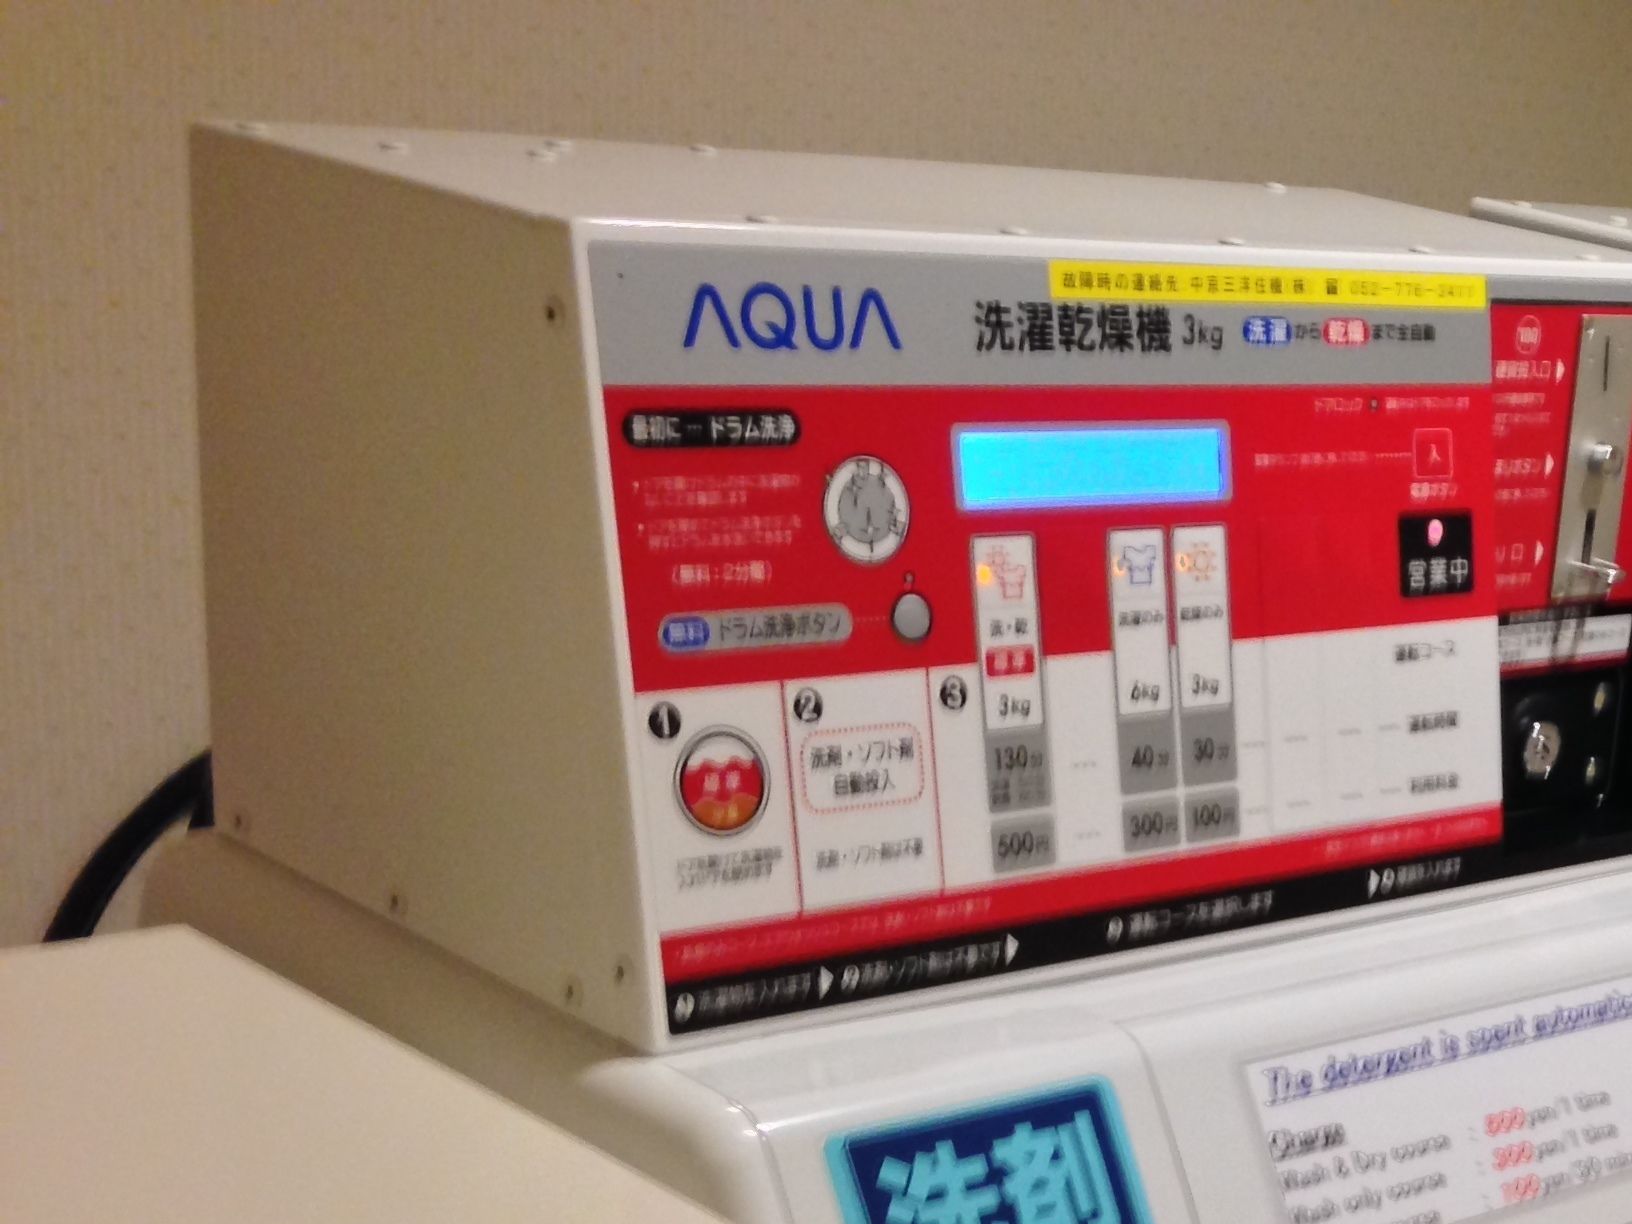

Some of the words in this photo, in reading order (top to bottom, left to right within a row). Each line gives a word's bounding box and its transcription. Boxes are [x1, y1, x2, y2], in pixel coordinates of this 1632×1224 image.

[683, 283, 902, 351] AQUA
[975, 301, 1172, 353] 洗濯乾燥機
[1182, 313, 1223, 350] 3kg
[1407, 556, 1469, 593] 営業中
[1263, 1065, 1313, 1100] The
